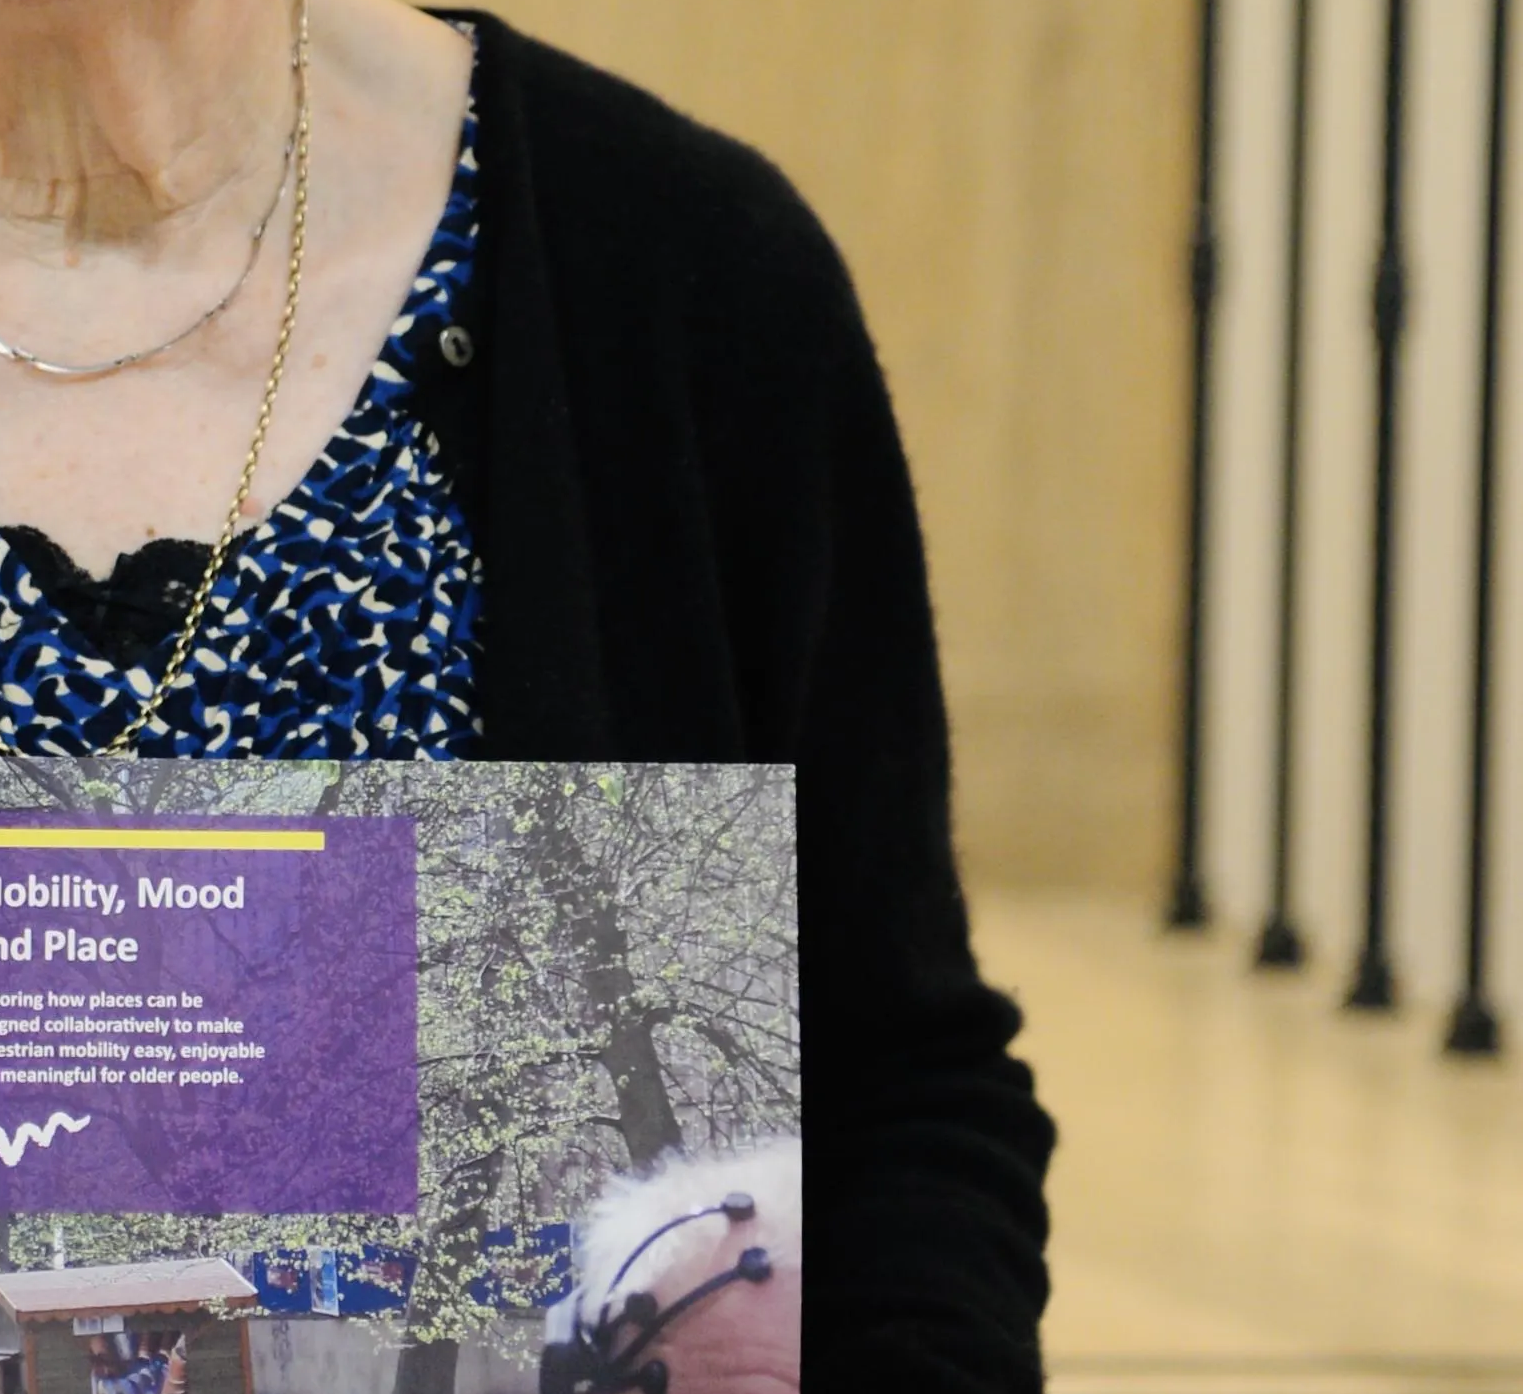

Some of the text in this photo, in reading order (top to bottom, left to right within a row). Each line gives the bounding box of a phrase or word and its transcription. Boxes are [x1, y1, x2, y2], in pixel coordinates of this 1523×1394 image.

[137, 875, 245, 910] Mood
[44, 927, 139, 963] Place
[47, 990, 86, 1008] how
[88, 990, 144, 1012] places
[146, 994, 178, 1009] can
[180, 990, 204, 1009] be
[43, 1015, 171, 1037] collaboratively
[172, 1017, 193, 1034] to
[196, 1016, 245, 1034] make
[58, 1040, 131, 1062] mobility
[133, 1044, 177, 1062] easy,
[179, 1041, 266, 1062] enjoyable
[0, 1065, 97, 1087] meaningful
[98, 1065, 126, 1084] for
[128, 1066, 176, 1084] older
[178, 1066, 244, 1088] people.
